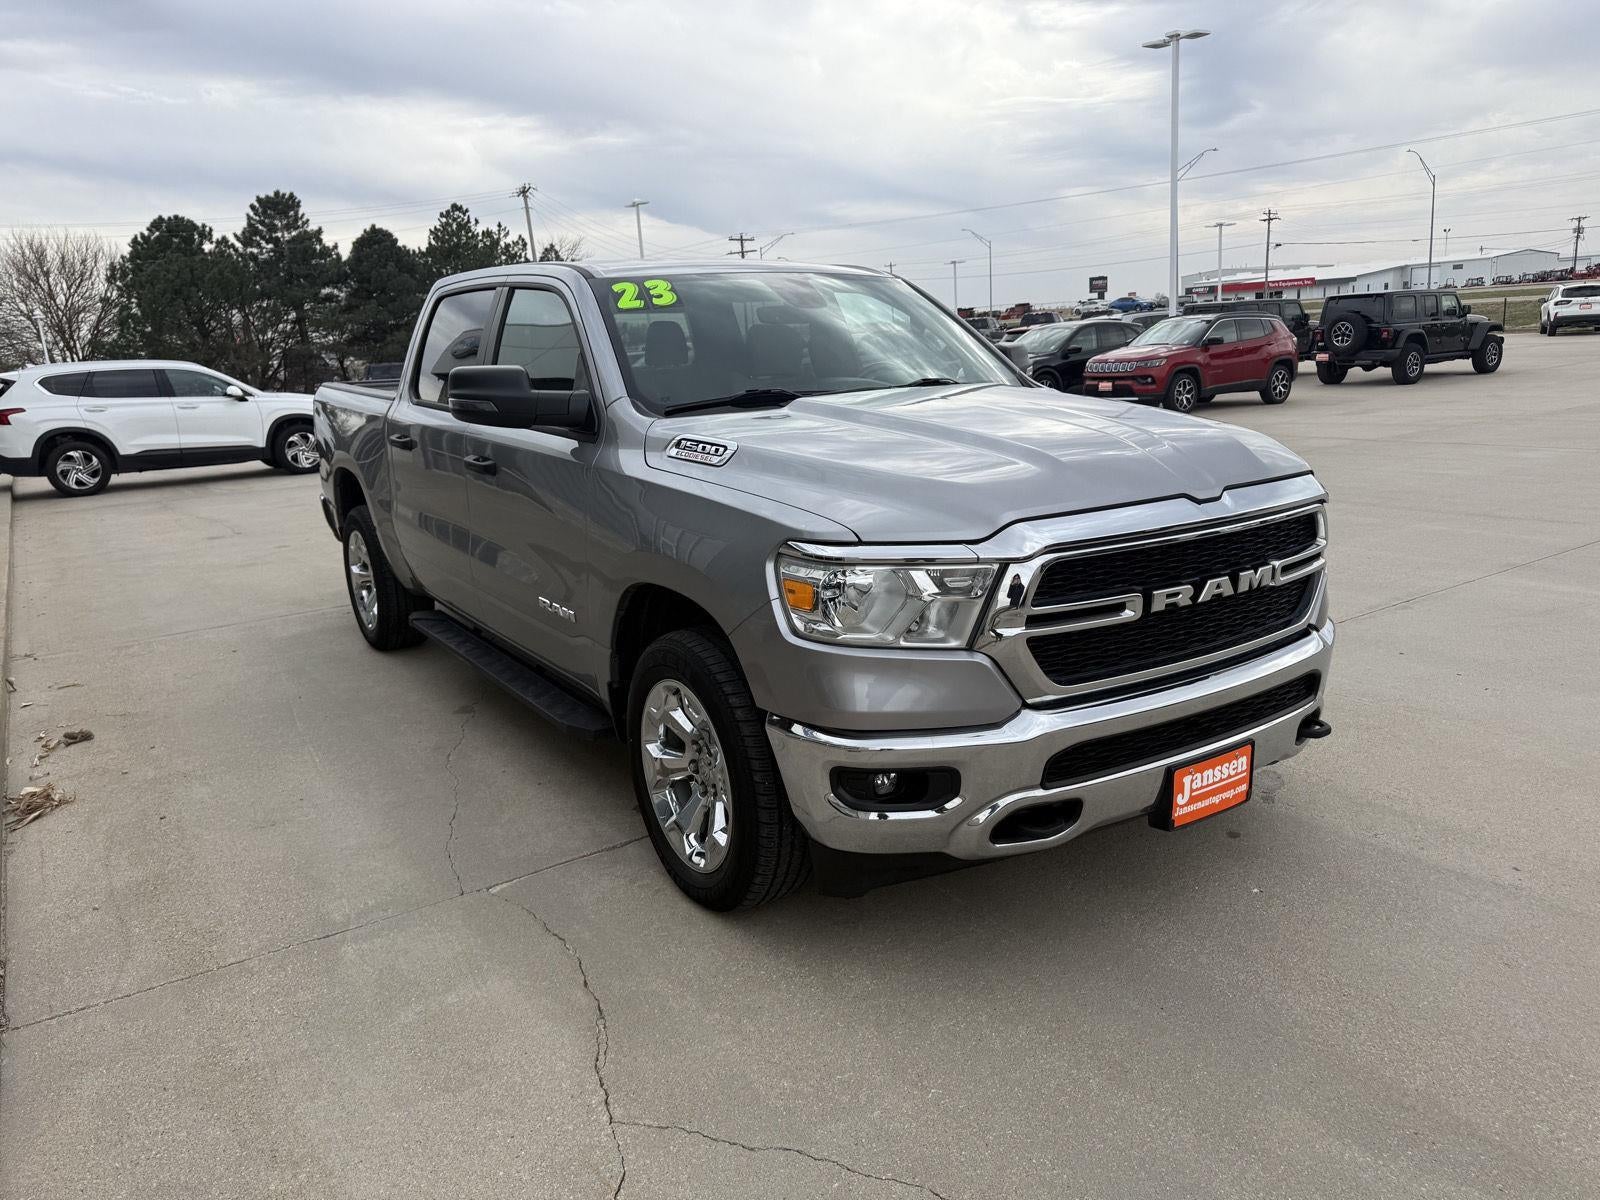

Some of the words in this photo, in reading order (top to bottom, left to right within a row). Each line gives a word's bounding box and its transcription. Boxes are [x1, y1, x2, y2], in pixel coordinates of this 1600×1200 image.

[612, 280, 677, 309] 23
[676, 450, 713, 462] ECODIESEL
[680, 440, 724, 456] 1500
[1151, 565, 1273, 613] RAM
[539, 596, 576, 623] RAM
[1177, 756, 1247, 805] Janssen
[1174, 783, 1247, 817] Janssenautogroup.com
